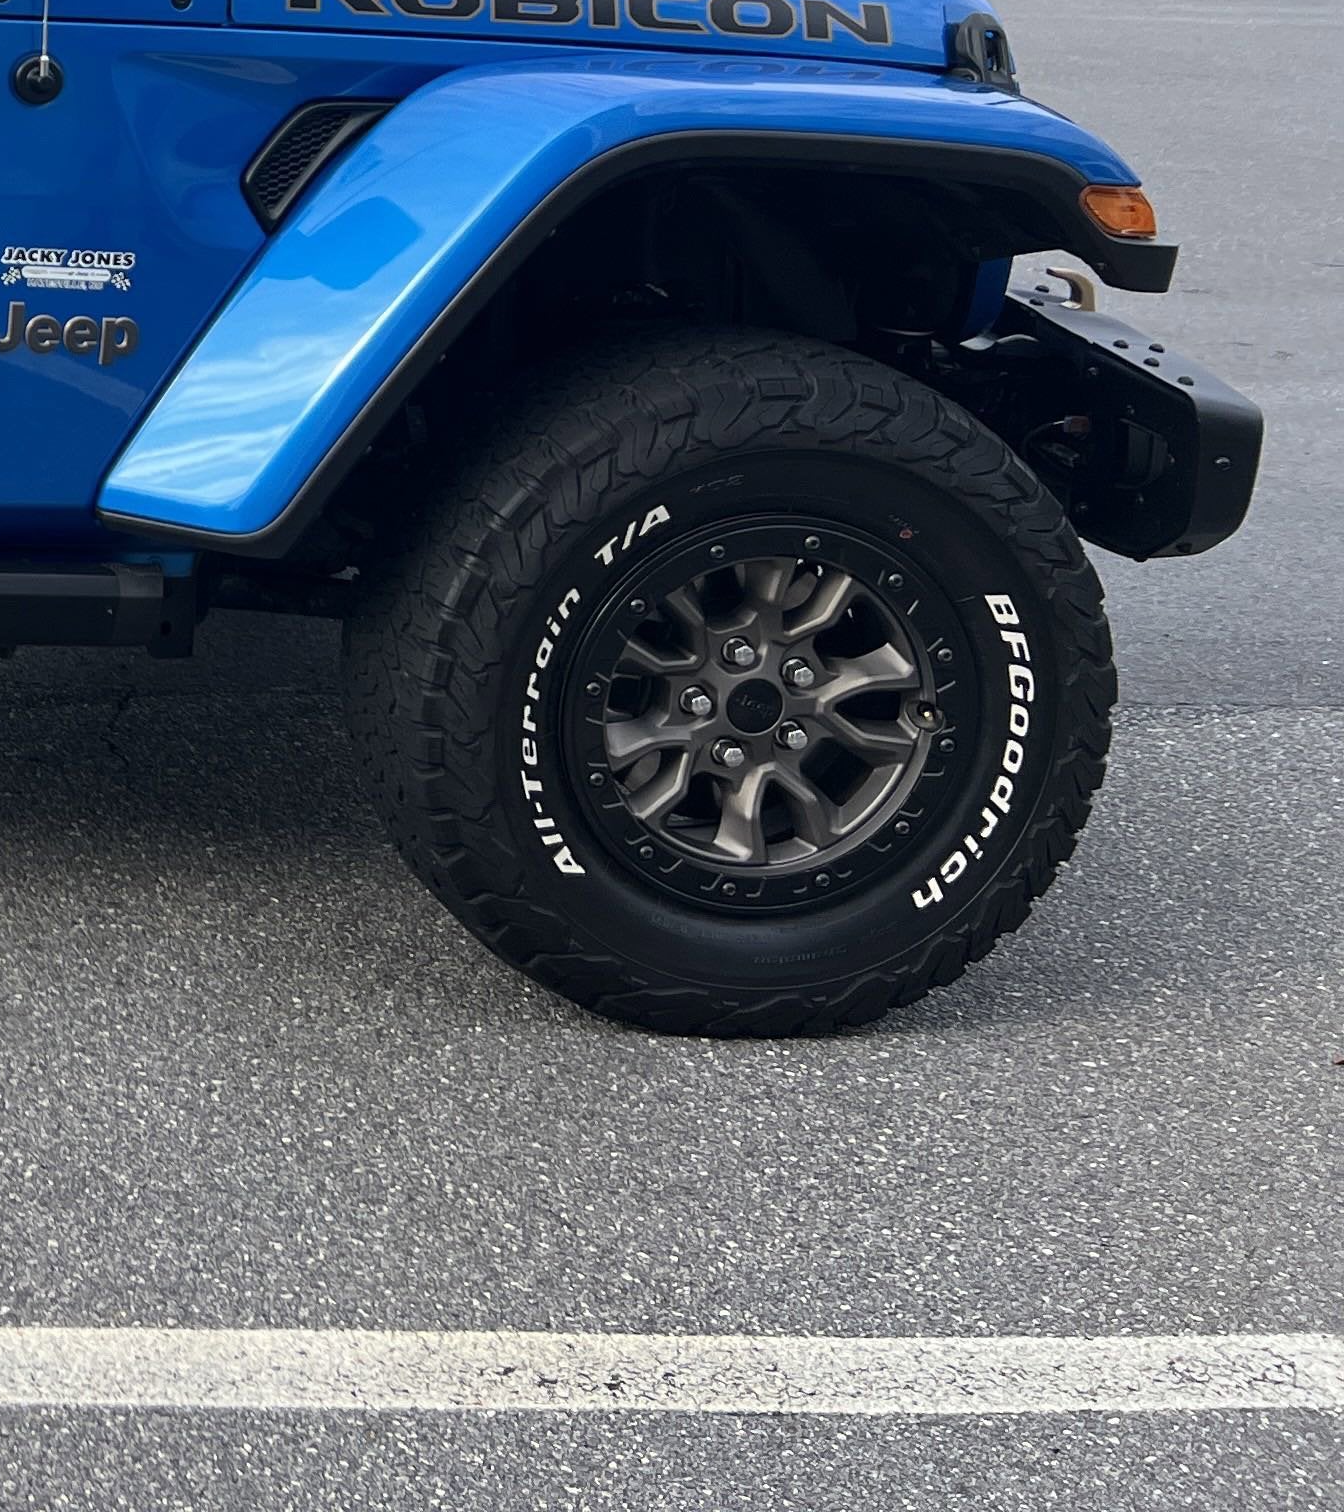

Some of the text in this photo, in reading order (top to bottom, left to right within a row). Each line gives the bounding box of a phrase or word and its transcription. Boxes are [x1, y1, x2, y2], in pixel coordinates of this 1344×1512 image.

[4, 247, 134, 267] JACKY JONES
[520, 505, 671, 874] All-Terrain T/A
[911, 594, 1035, 908] BFGoodrich
